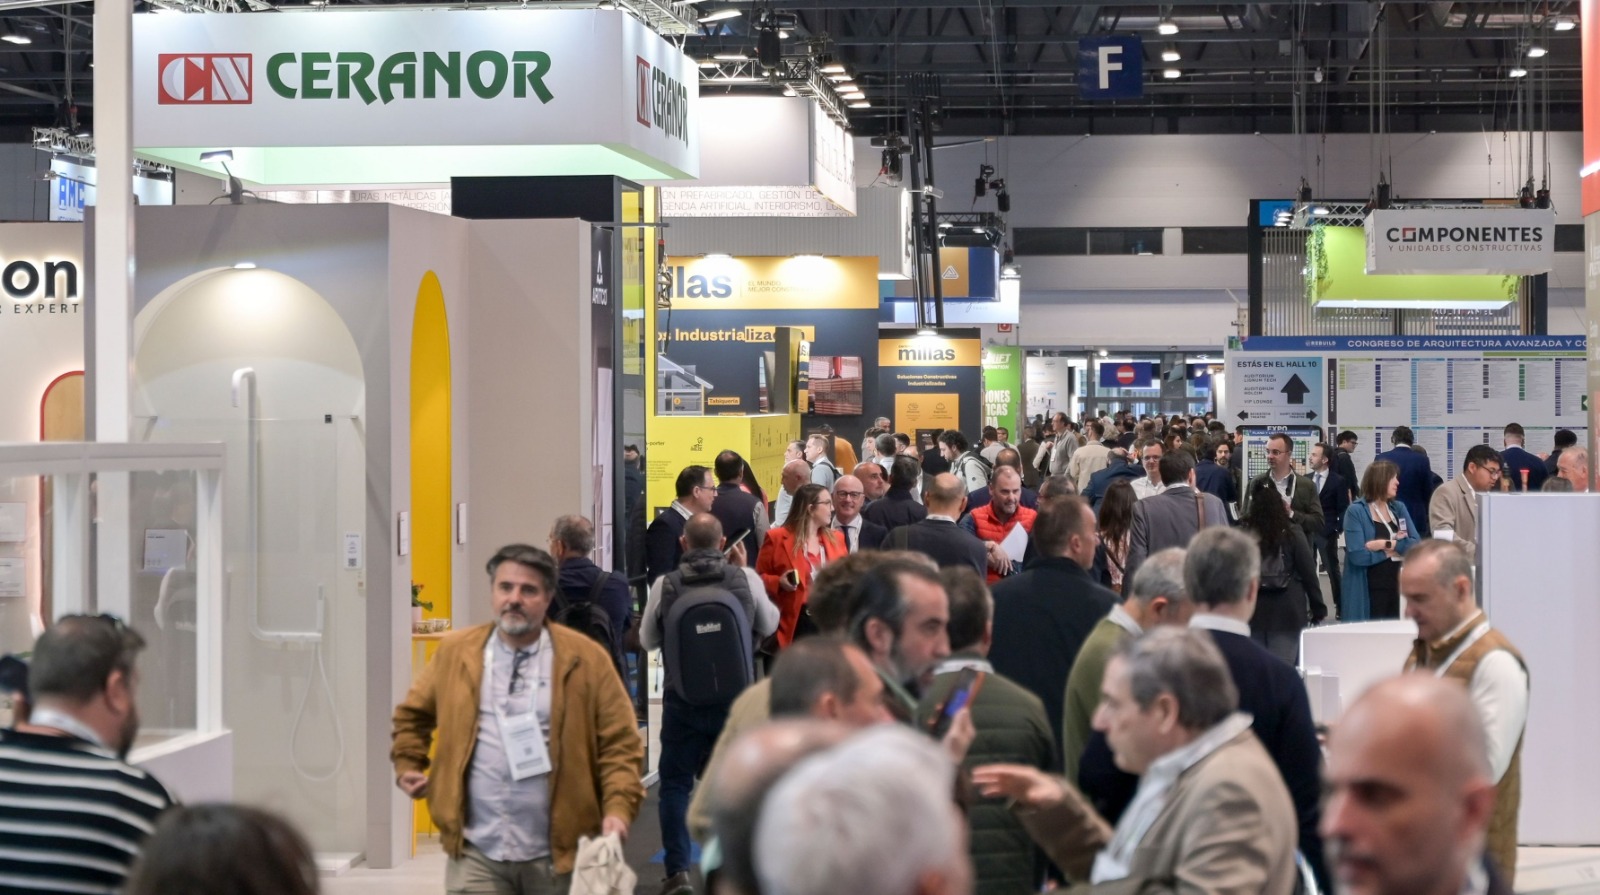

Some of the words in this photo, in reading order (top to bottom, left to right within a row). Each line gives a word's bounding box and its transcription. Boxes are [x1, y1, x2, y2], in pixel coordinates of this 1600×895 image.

[1098, 46, 1123, 89] F
[266, 50, 554, 105] CERANOR
[652, 66, 689, 149] CERANOR
[384, 190, 436, 201] METÁLICAS
[759, 189, 801, 199] GESTIÓN
[805, 190, 817, 199] DE
[1386, 227, 1543, 243] COMPONENTES
[1398, 244, 1451, 252] UNIDADES
[1455, 244, 1542, 252] CONSTRUCTIVAS
[14, 303, 79, 314] EXPERT
[1347, 340, 1404, 348] CONGRESO
[1407, 340, 1420, 348] DE
[1423, 340, 1502, 349] ARQUITECTURA
[1505, 340, 1562, 348] AVANZADA
[1565, 340, 1573, 348] Y
[898, 347, 956, 361] millas
[1237, 360, 1262, 368] ESTÁS
